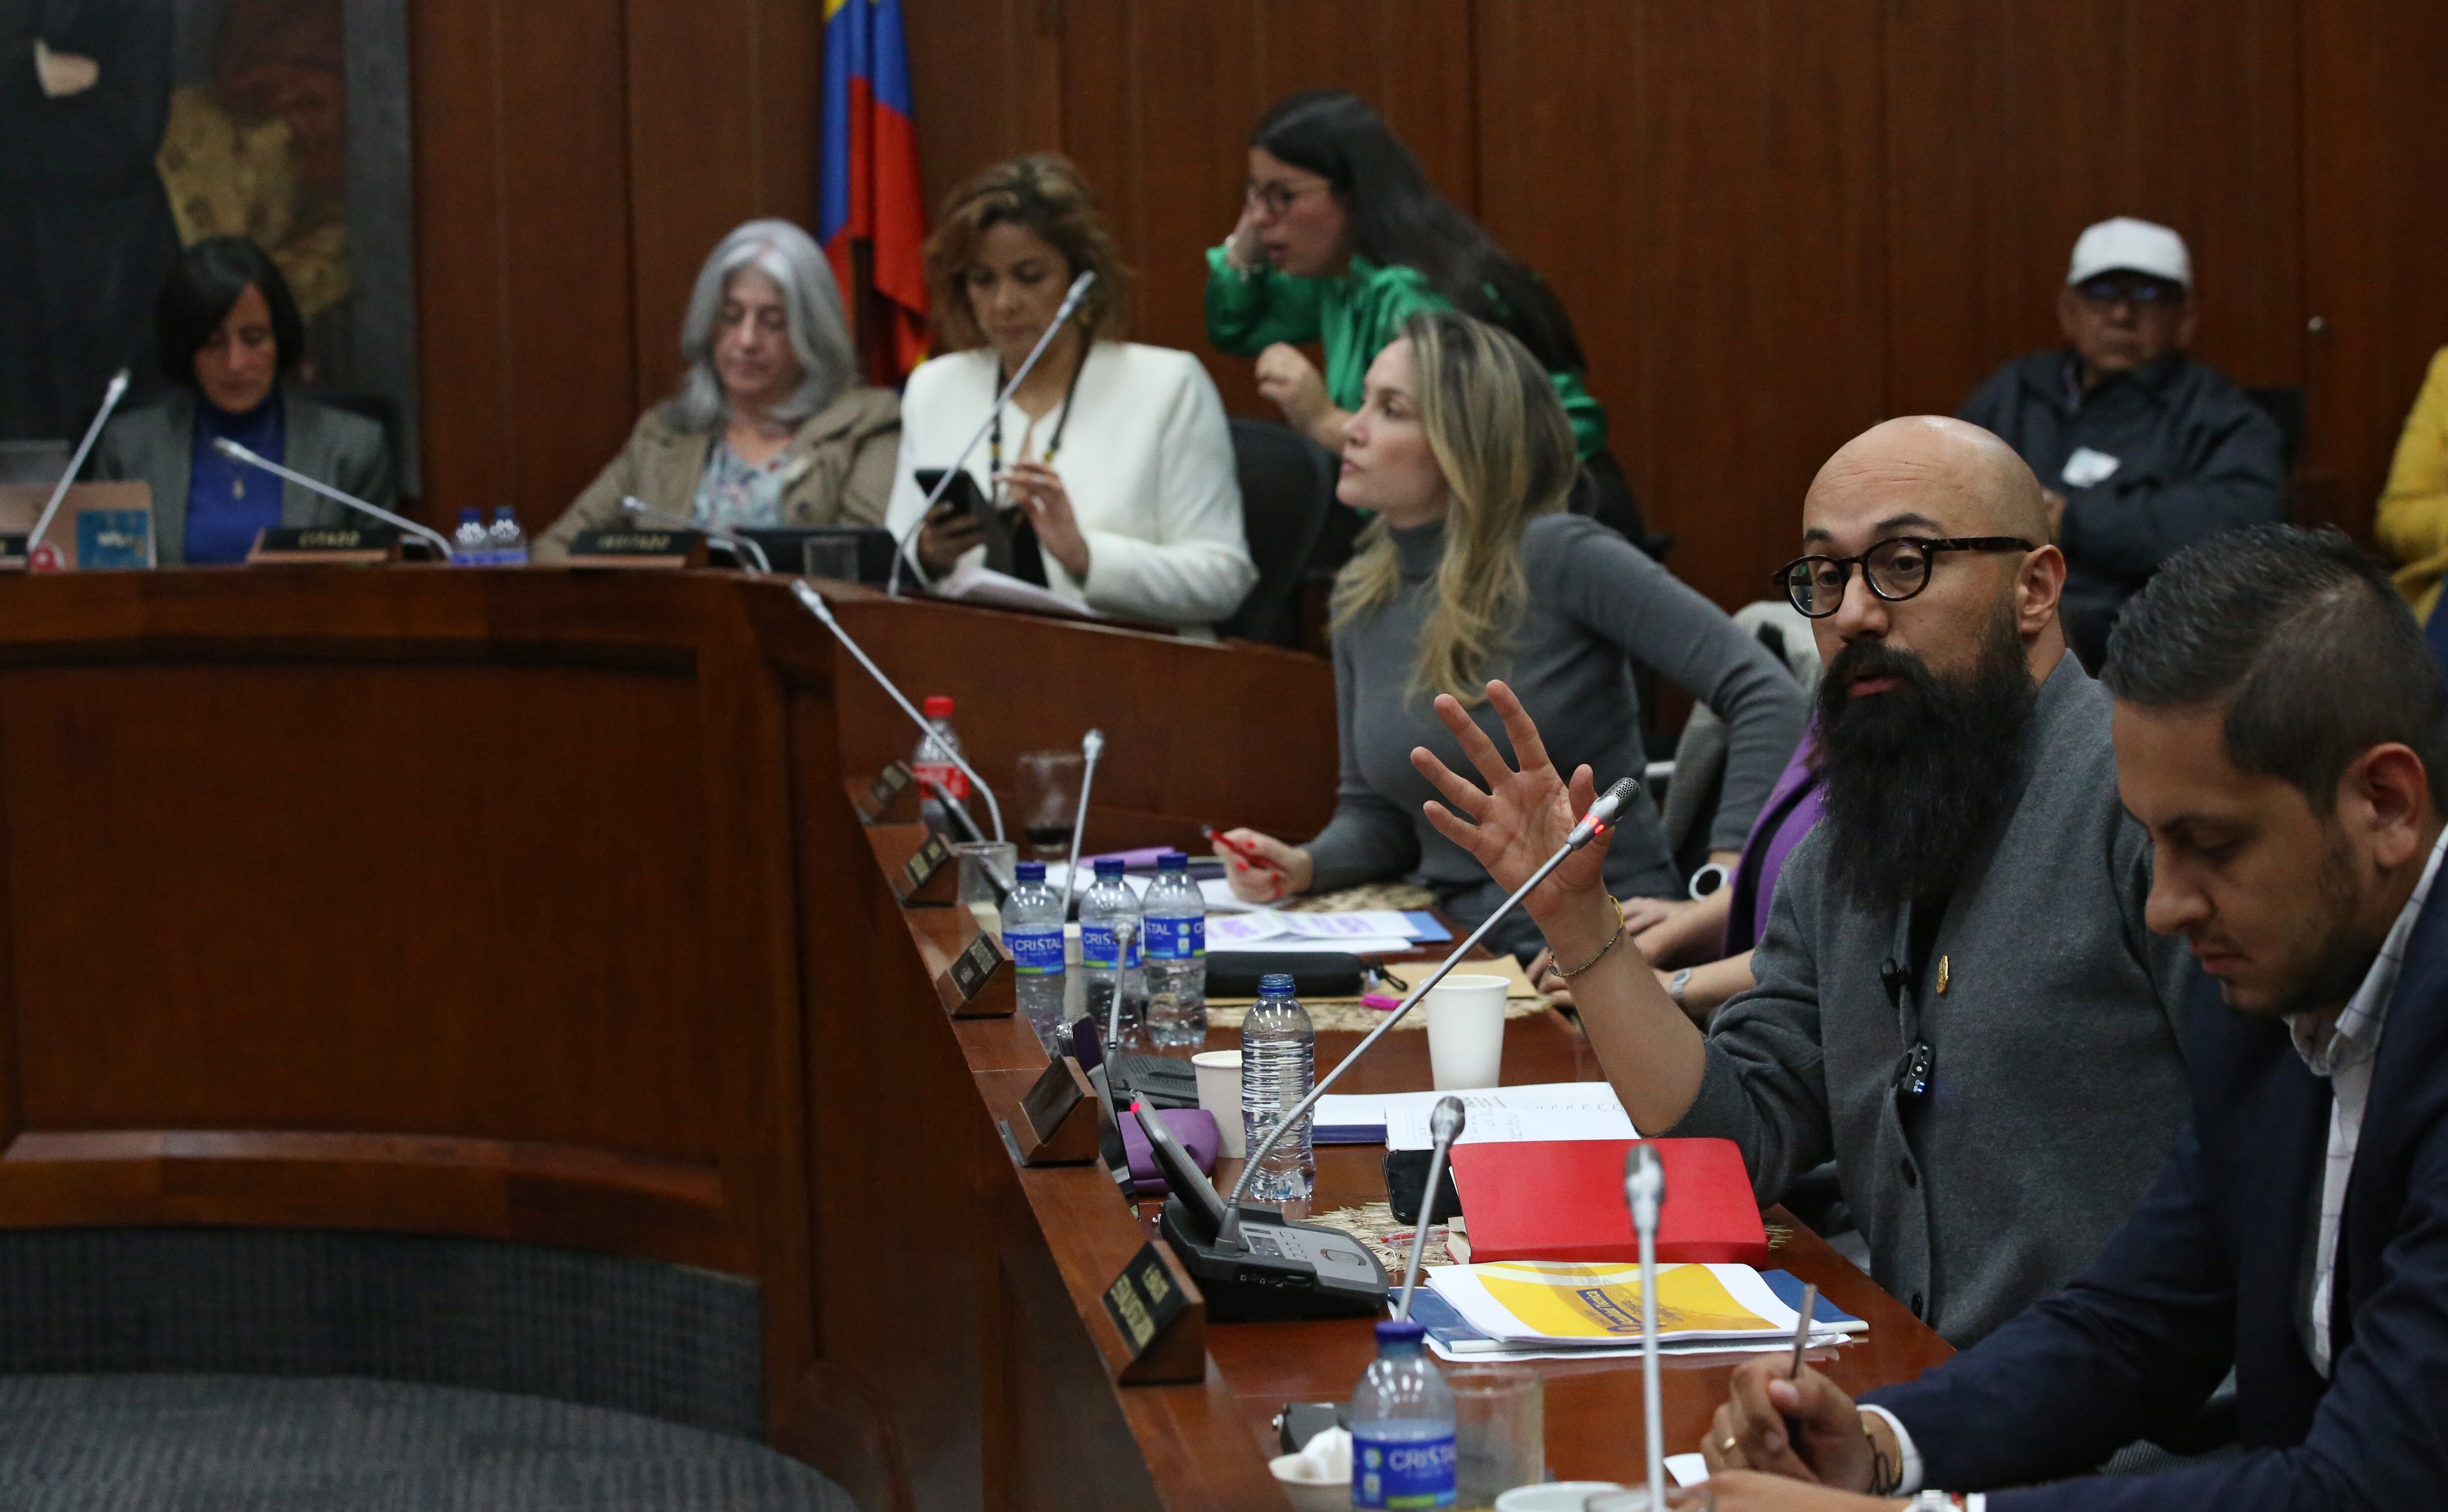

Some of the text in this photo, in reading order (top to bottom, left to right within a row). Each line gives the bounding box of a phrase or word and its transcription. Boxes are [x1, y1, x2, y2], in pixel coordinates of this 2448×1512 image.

[1145, 923, 1172, 936] STAL
[1014, 937, 1062, 952] CRISTAL
[1084, 933, 1112, 946] CRIS
